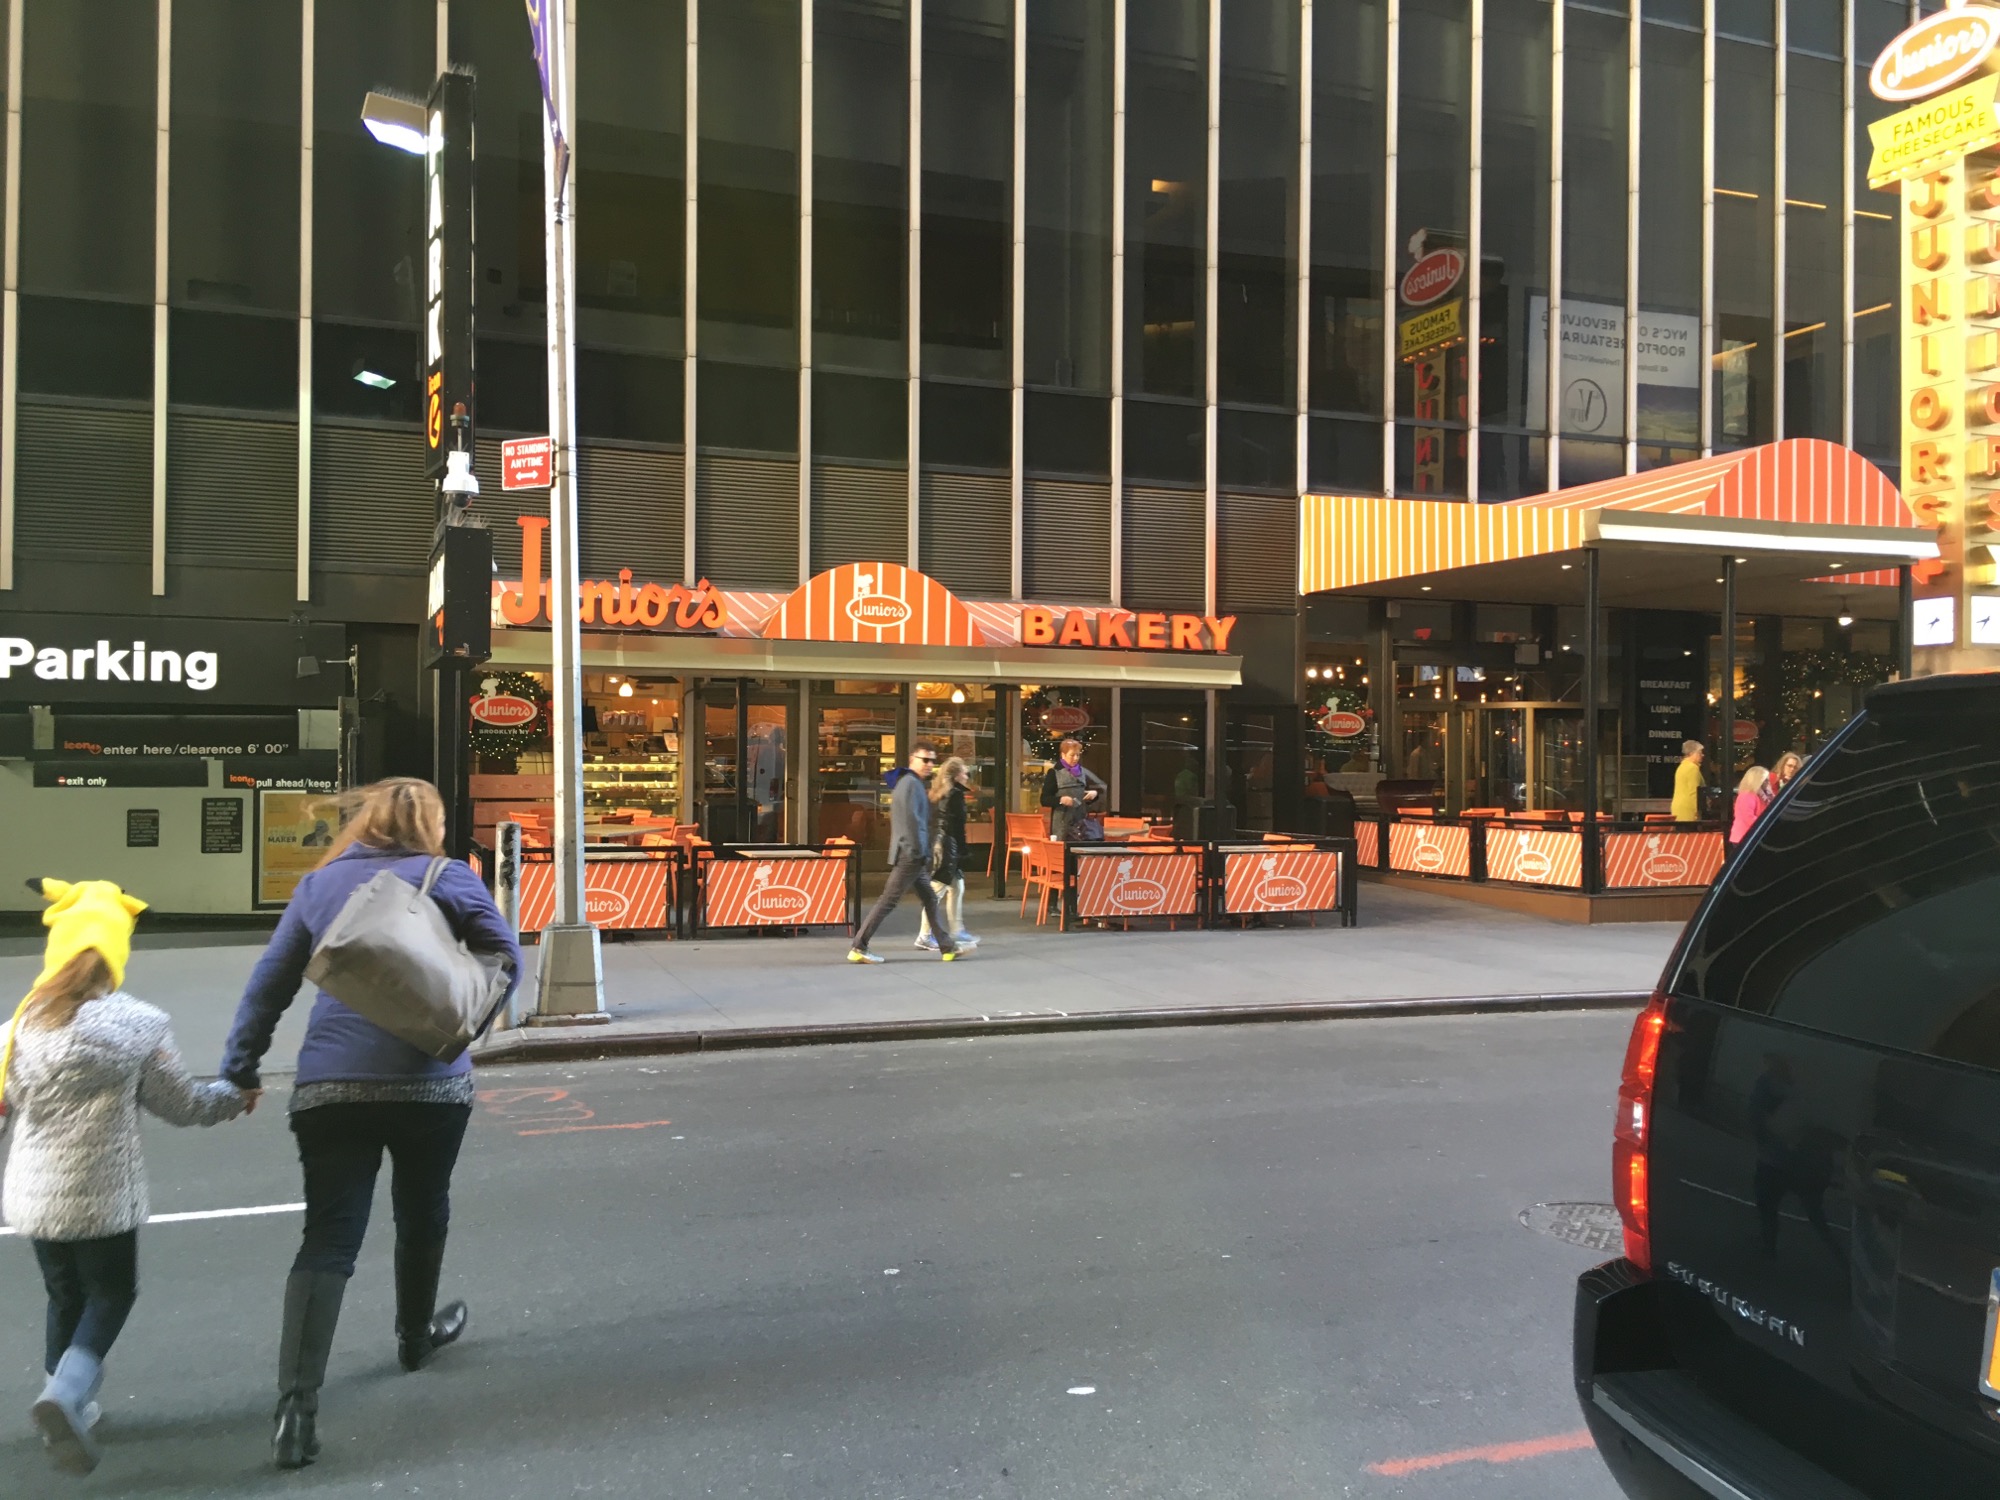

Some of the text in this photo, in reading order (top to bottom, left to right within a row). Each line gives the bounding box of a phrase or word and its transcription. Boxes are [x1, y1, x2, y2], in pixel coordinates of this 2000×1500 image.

[1893, 95, 1974, 141] FAMOUS
[1881, 111, 1986, 164] CHEESECAKE
[1909, 170, 1942, 529] JUNIORS
[505, 442, 549, 456] NO STANDING
[511, 455, 544, 469] ANYTIME
[854, 592, 908, 618] Junior's
[1021, 608, 1237, 651] BAKERY
[0, 637, 218, 691] Parking
[1640, 681, 1691, 689] BREAKFAST
[479, 691, 530, 717] Junior's
[1651, 705, 1682, 713] LUNCH
[1648, 730, 1682, 739] DINNER
[64, 740, 89, 751] icon
[103, 744, 138, 755] enter
[143, 743, 243, 755] here/clearence
[247, 743, 260, 755] 6'
[66, 777, 107, 788] exit only
[229, 774, 248, 784] icon
[256, 779, 272, 789] pull
[275, 778, 332, 789] ahead/keep
[267, 835, 298, 843] MAKER
[753, 884, 805, 912] Junior's
[1117, 878, 1161, 903] Junior's
[1261, 874, 1301, 899] Junior's
[585, 897, 622, 913] nior's
[1666, 1260, 1805, 1346] SUBURBAN
